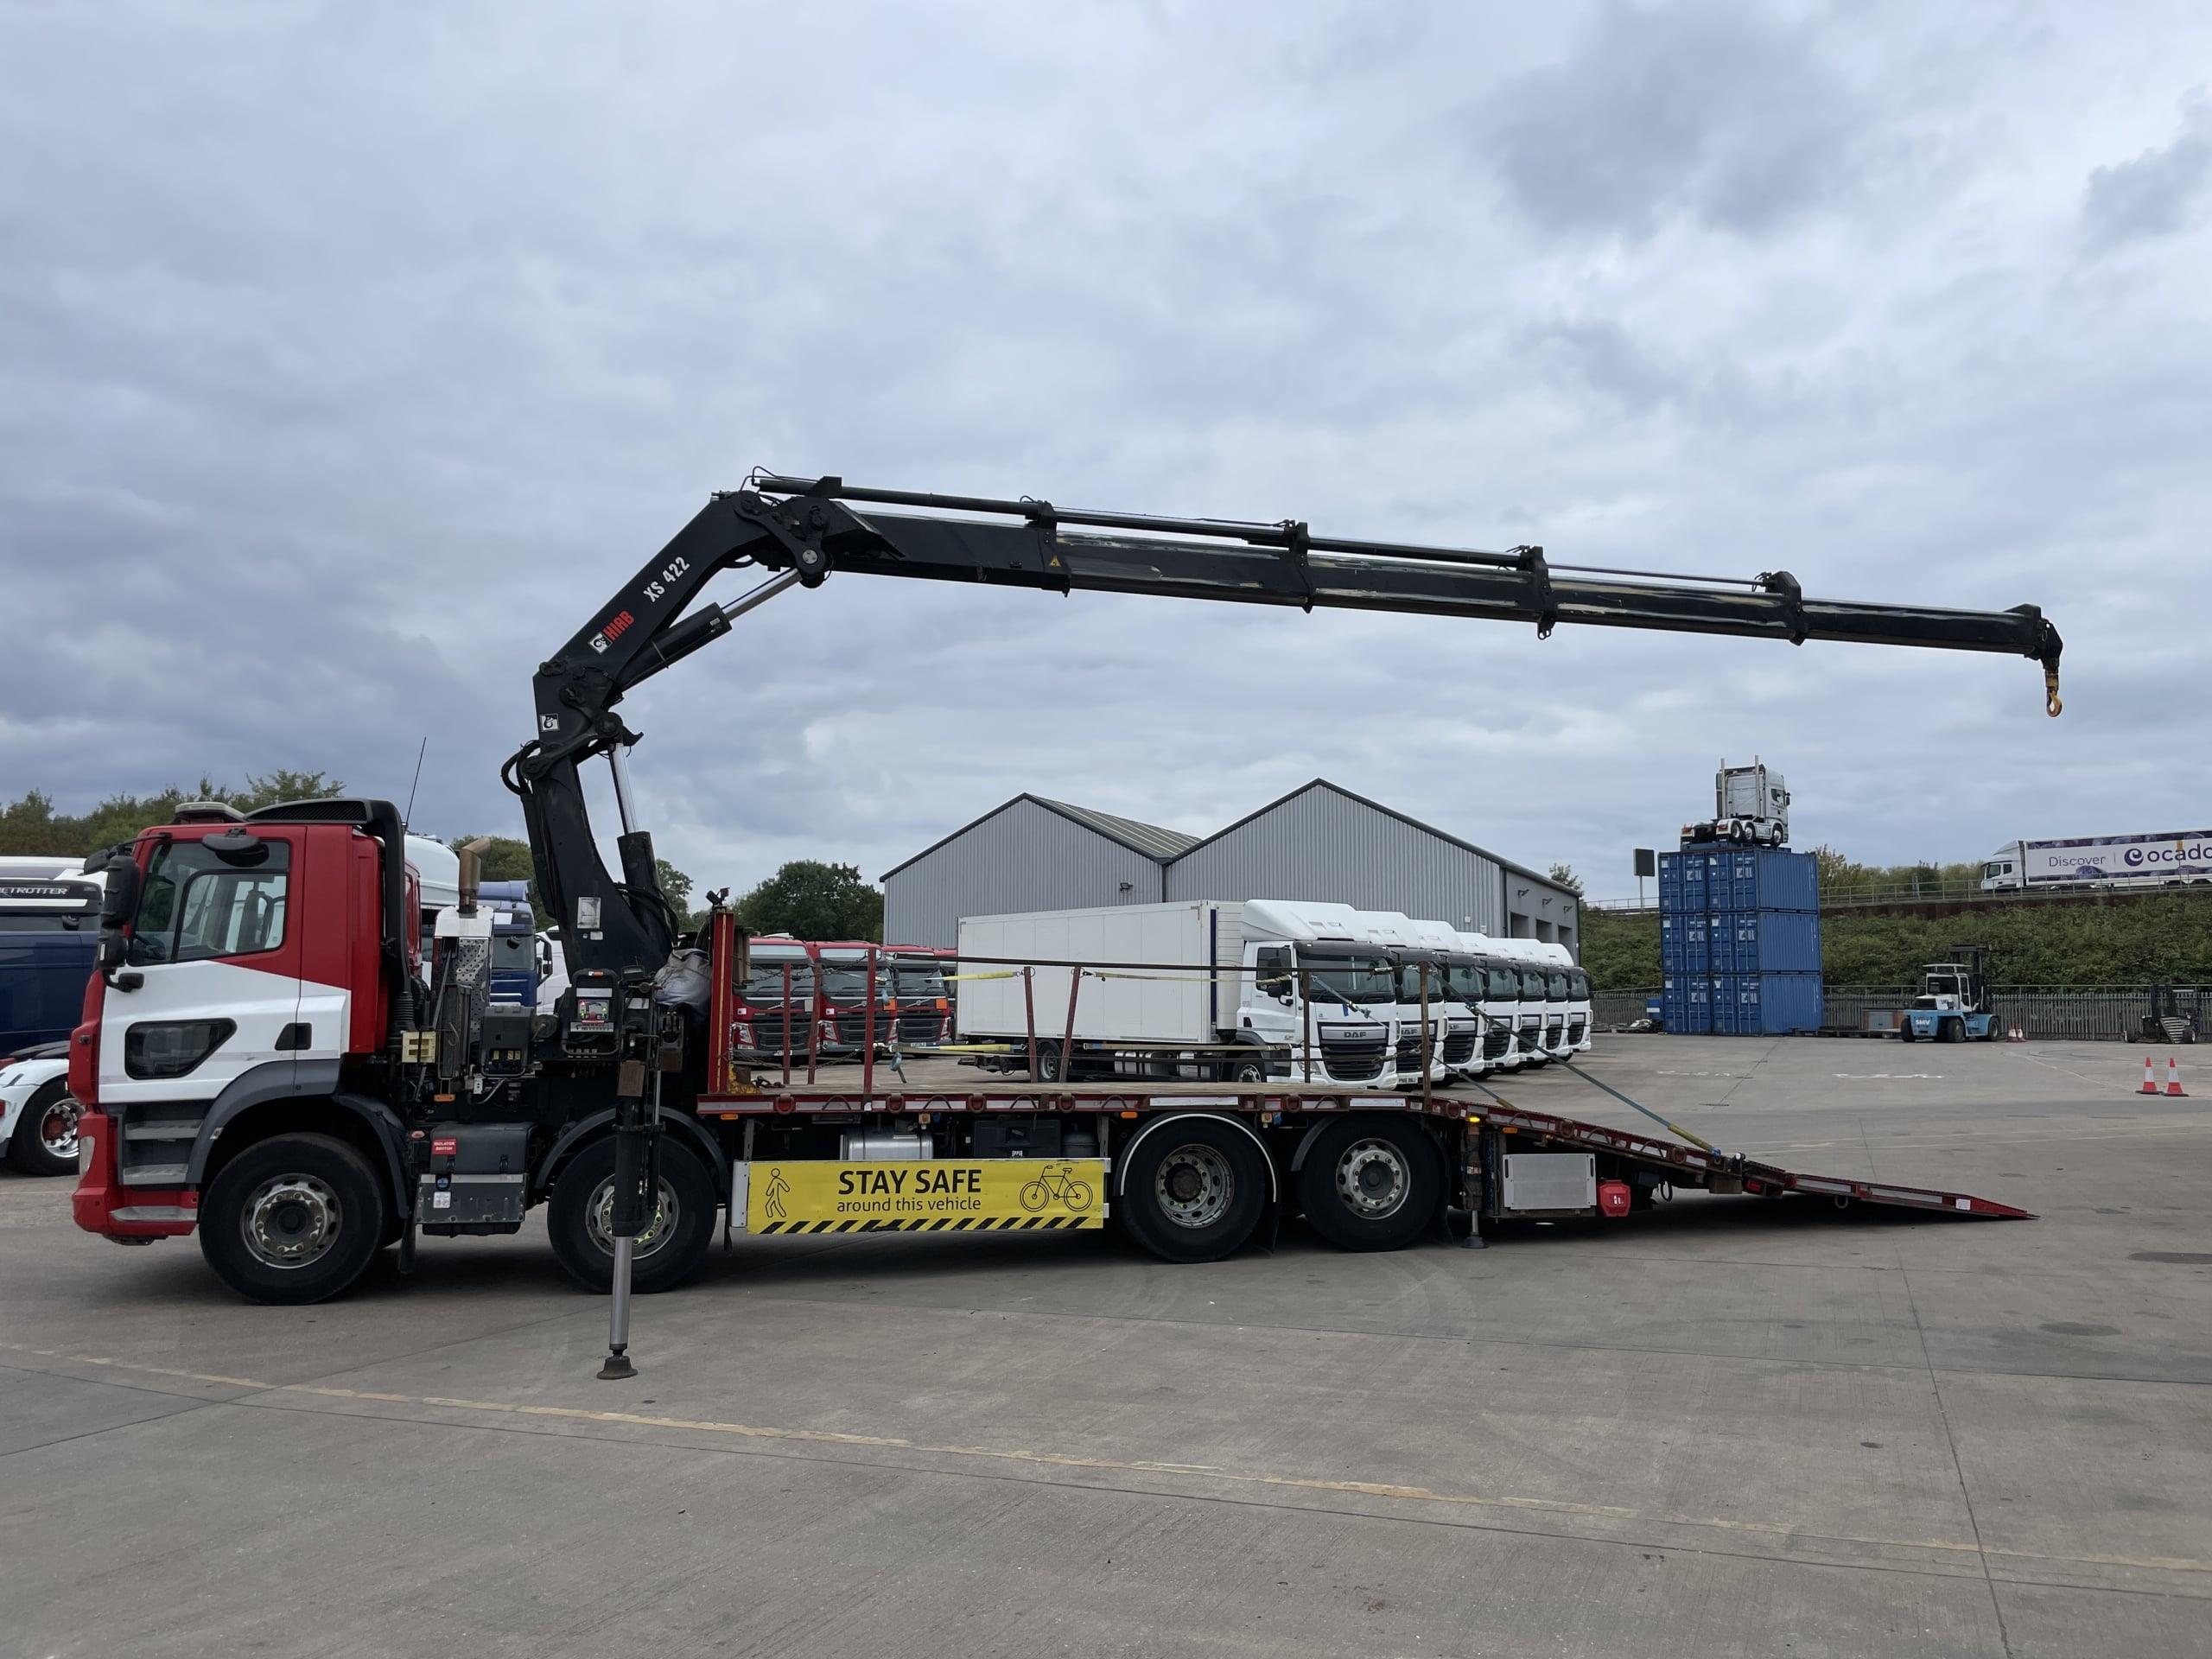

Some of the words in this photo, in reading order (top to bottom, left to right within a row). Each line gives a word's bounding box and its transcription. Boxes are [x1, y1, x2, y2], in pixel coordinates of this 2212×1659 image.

[643, 582, 665, 602] XS
[662, 556, 690, 582] 422
[602, 610, 635, 641] HIAB
[2049, 855, 2107, 867] Discover
[2147, 843, 2212, 862] ocado
[838, 1170, 908, 1195] STAY
[915, 1169, 982, 1194] SAFE
[837, 1198, 891, 1211] around
[896, 1197, 923, 1211] this
[928, 1196, 982, 1211] vehicle
